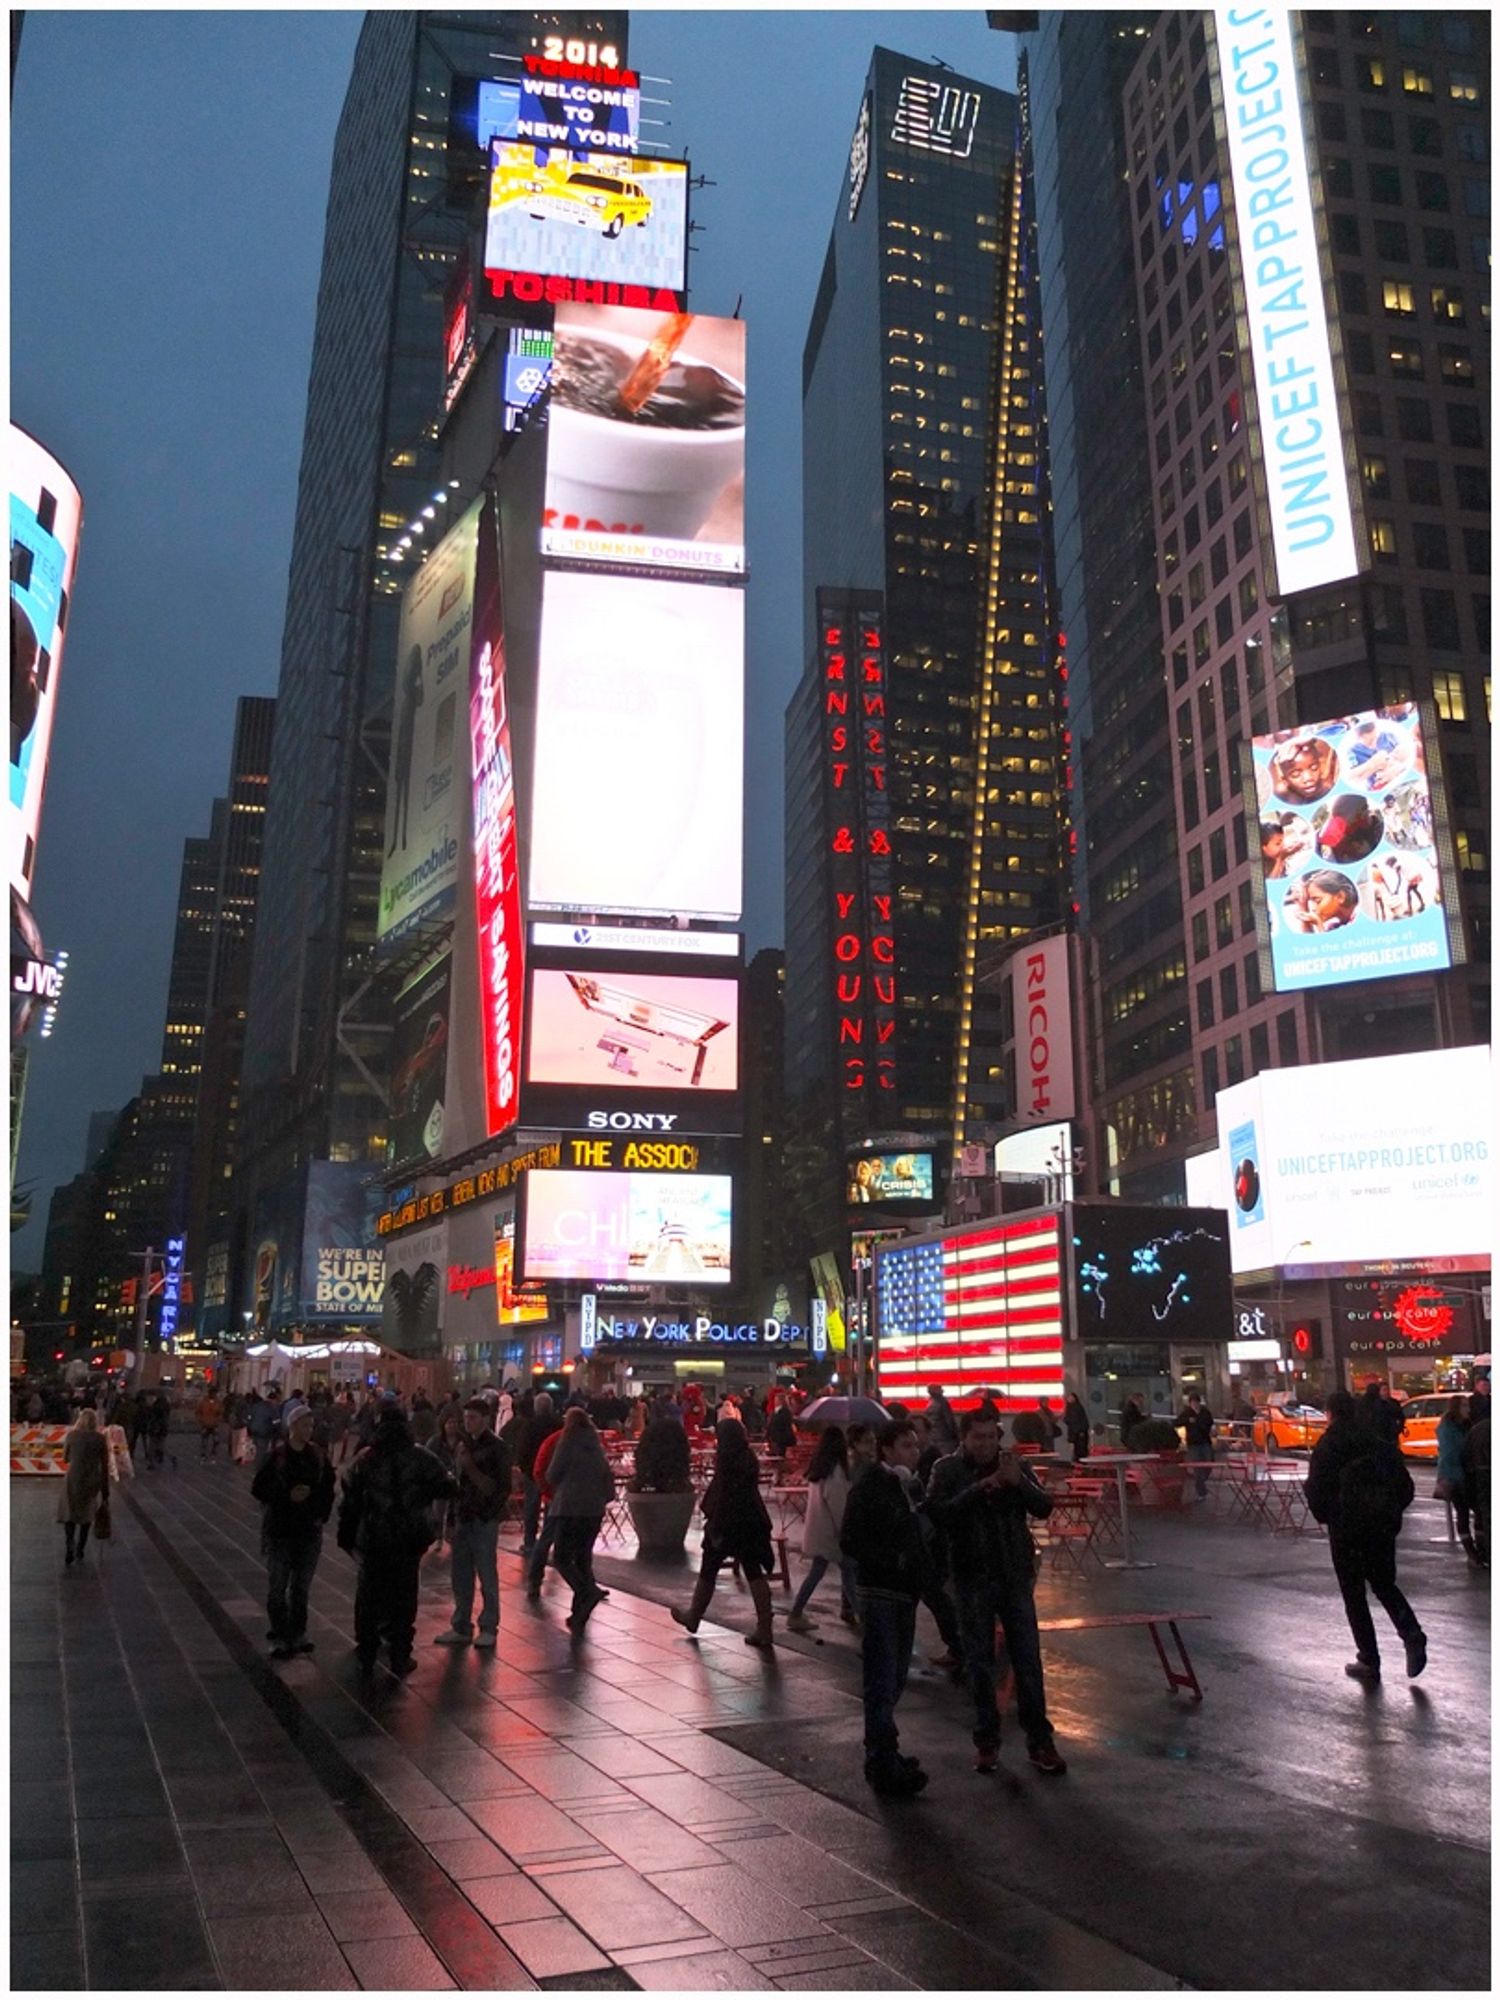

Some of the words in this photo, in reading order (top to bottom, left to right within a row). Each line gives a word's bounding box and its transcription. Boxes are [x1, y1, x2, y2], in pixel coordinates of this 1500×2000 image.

[544, 36, 618, 69] 2014
[523, 55, 638, 89] TOSHIBA
[523, 79, 635, 108] WELCOME
[564, 105, 595, 123] TO
[517, 119, 569, 141] NEW
[575, 126, 639, 150] YORK
[484, 267, 680, 313] TOSHIBA
[651, 545, 724, 565] DONUTS
[825, 628, 848, 789] ERNST
[832, 827, 854, 853] &
[596, 930, 624, 946] 21ST
[624, 933, 677, 947] CENTURY
[1293, 946, 1318, 957] Take
[1320, 943, 1340, 954] the
[1342, 934, 1399, 951] challenge
[14, 960, 57, 997] JVC
[835, 892, 864, 1089] YOUNG
[1026, 952, 1051, 1109] RICOH
[588, 1111, 677, 1131] SONY
[571, 1140, 612, 1167] THE
[1277, 1140, 1489, 1177] UNICEFTAPPROJECT.ORG
[1412, 1173, 1459, 1191] unicef
[318, 1248, 362, 1260] WE'RE
[366, 1249, 383, 1260] IN
[316, 1303, 346, 1312] STATE
[348, 1303, 363, 1312] OF
[696, 1317, 757, 1343] POLICE
[815, 1301, 825, 1349] NYPD
